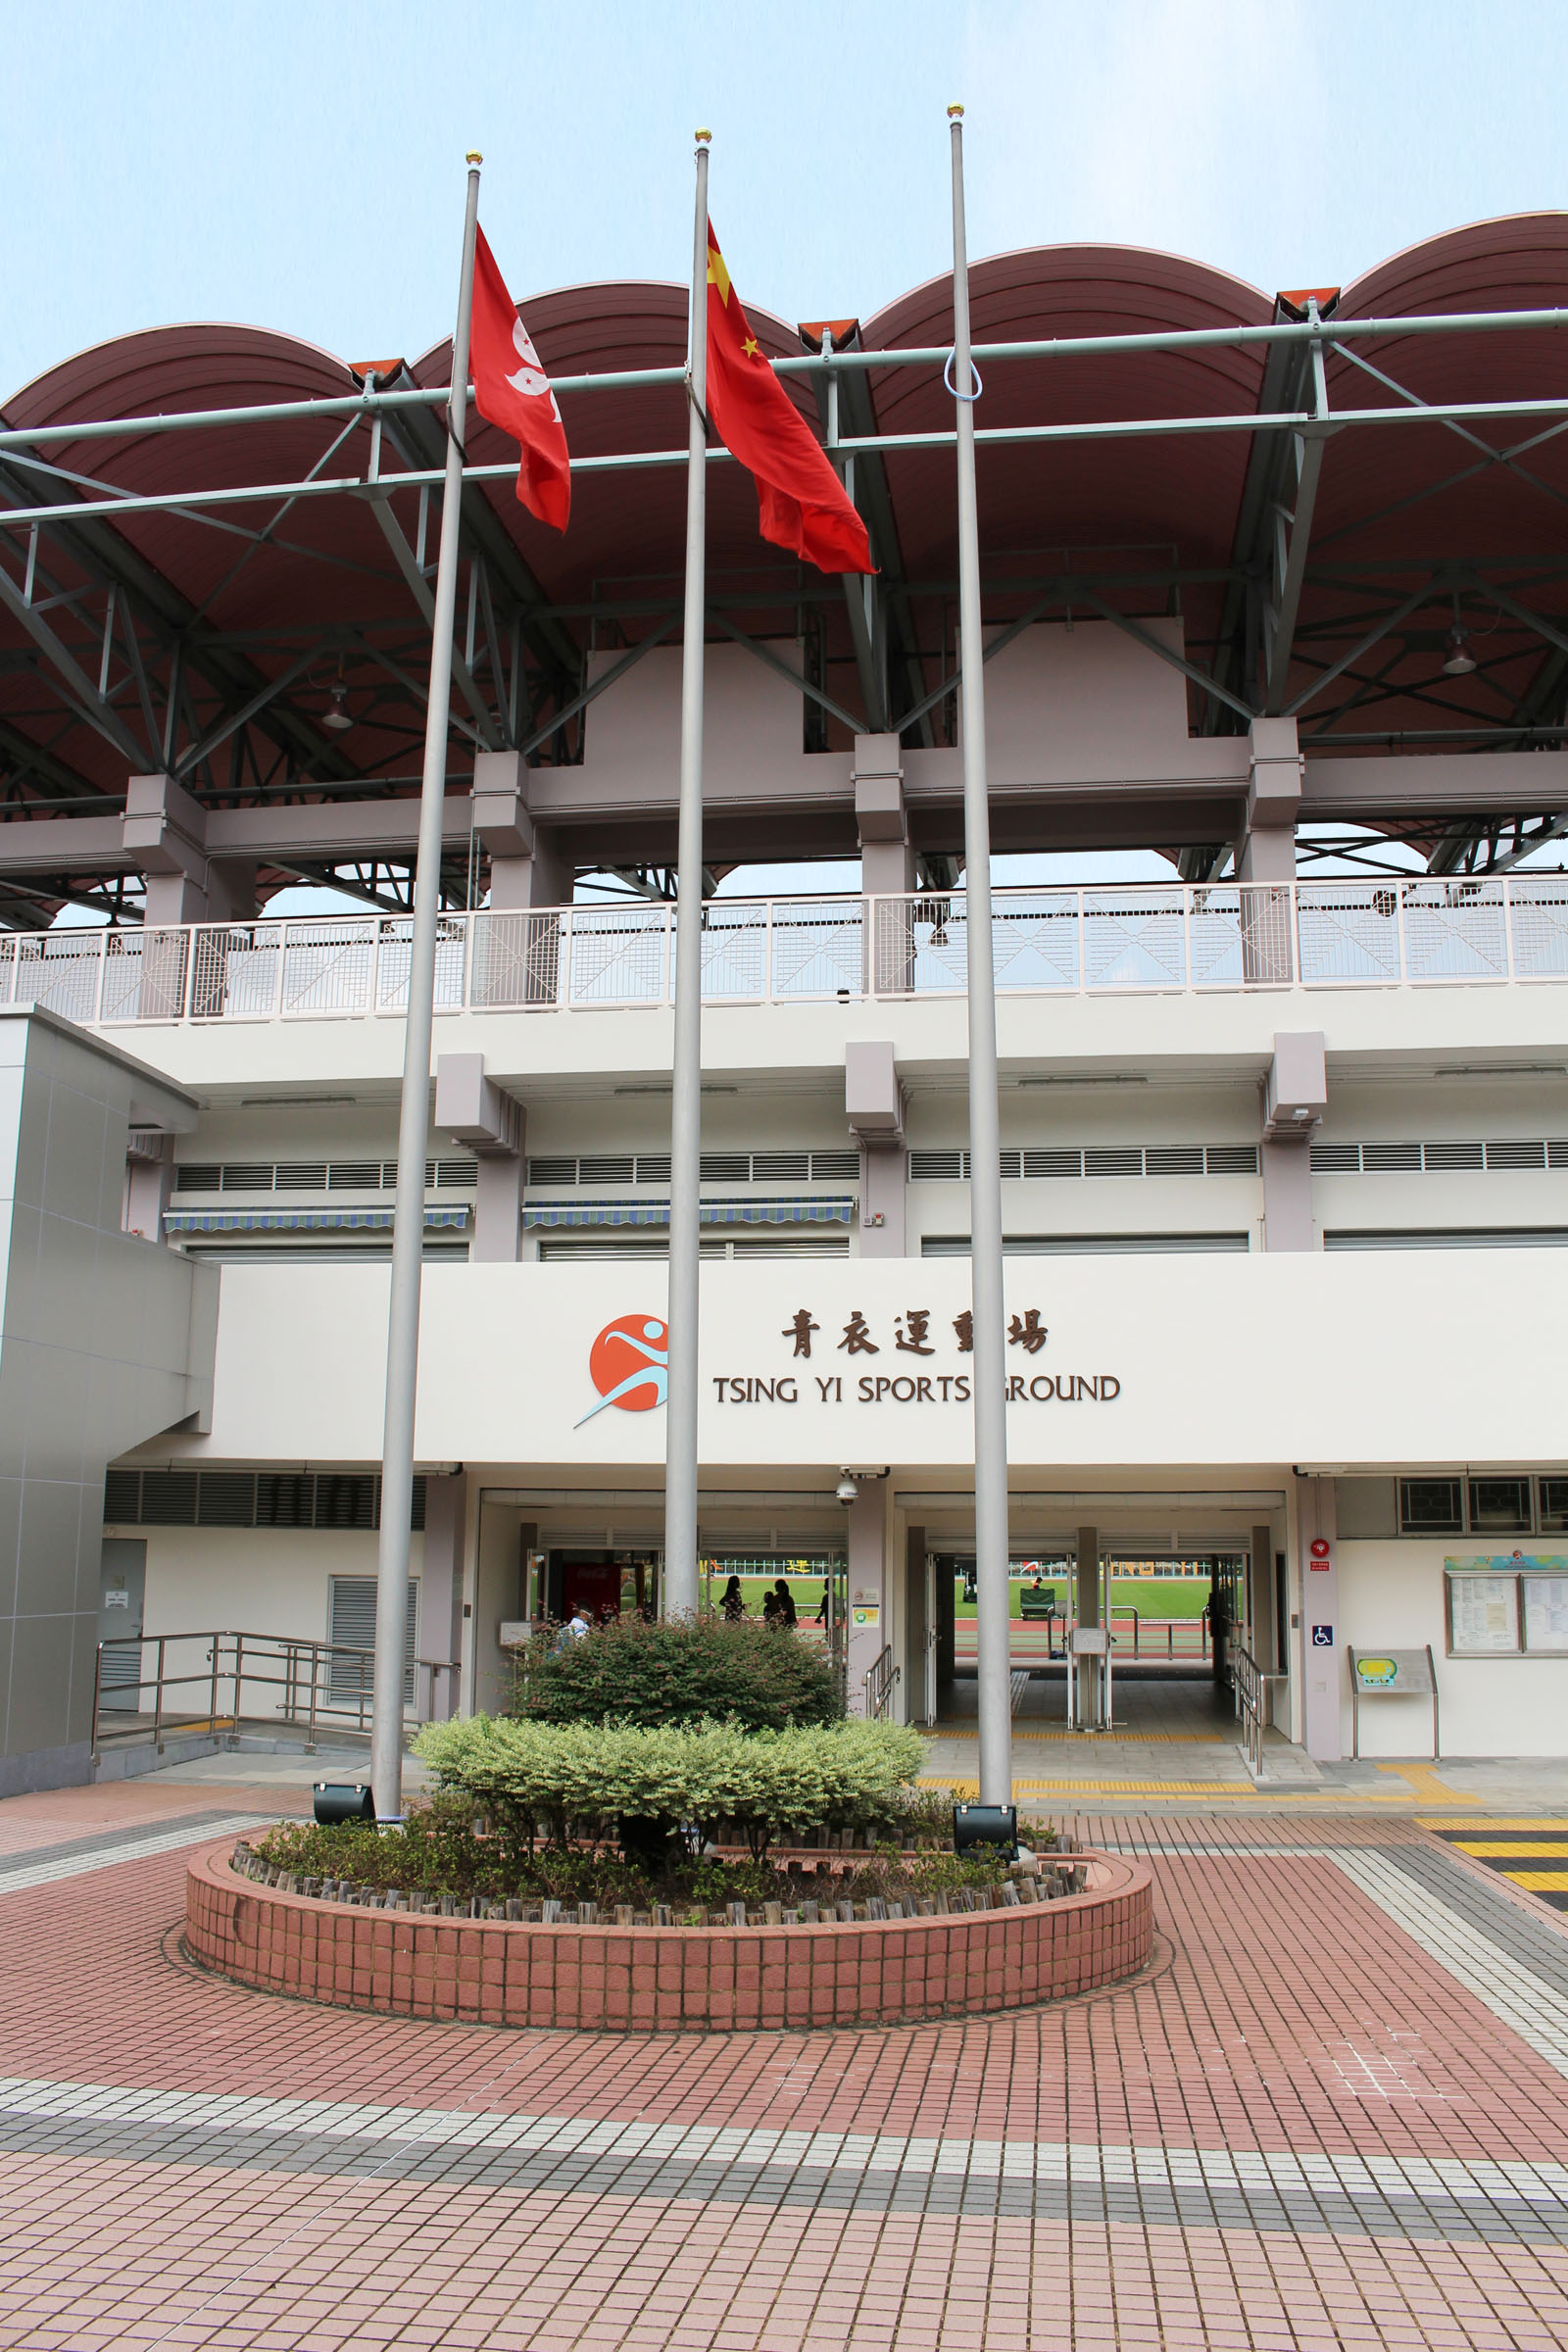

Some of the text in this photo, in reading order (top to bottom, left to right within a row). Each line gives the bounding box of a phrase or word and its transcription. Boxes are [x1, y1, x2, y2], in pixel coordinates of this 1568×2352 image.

[712, 1375, 1121, 1403] TSING YI SPORTS ROUND
